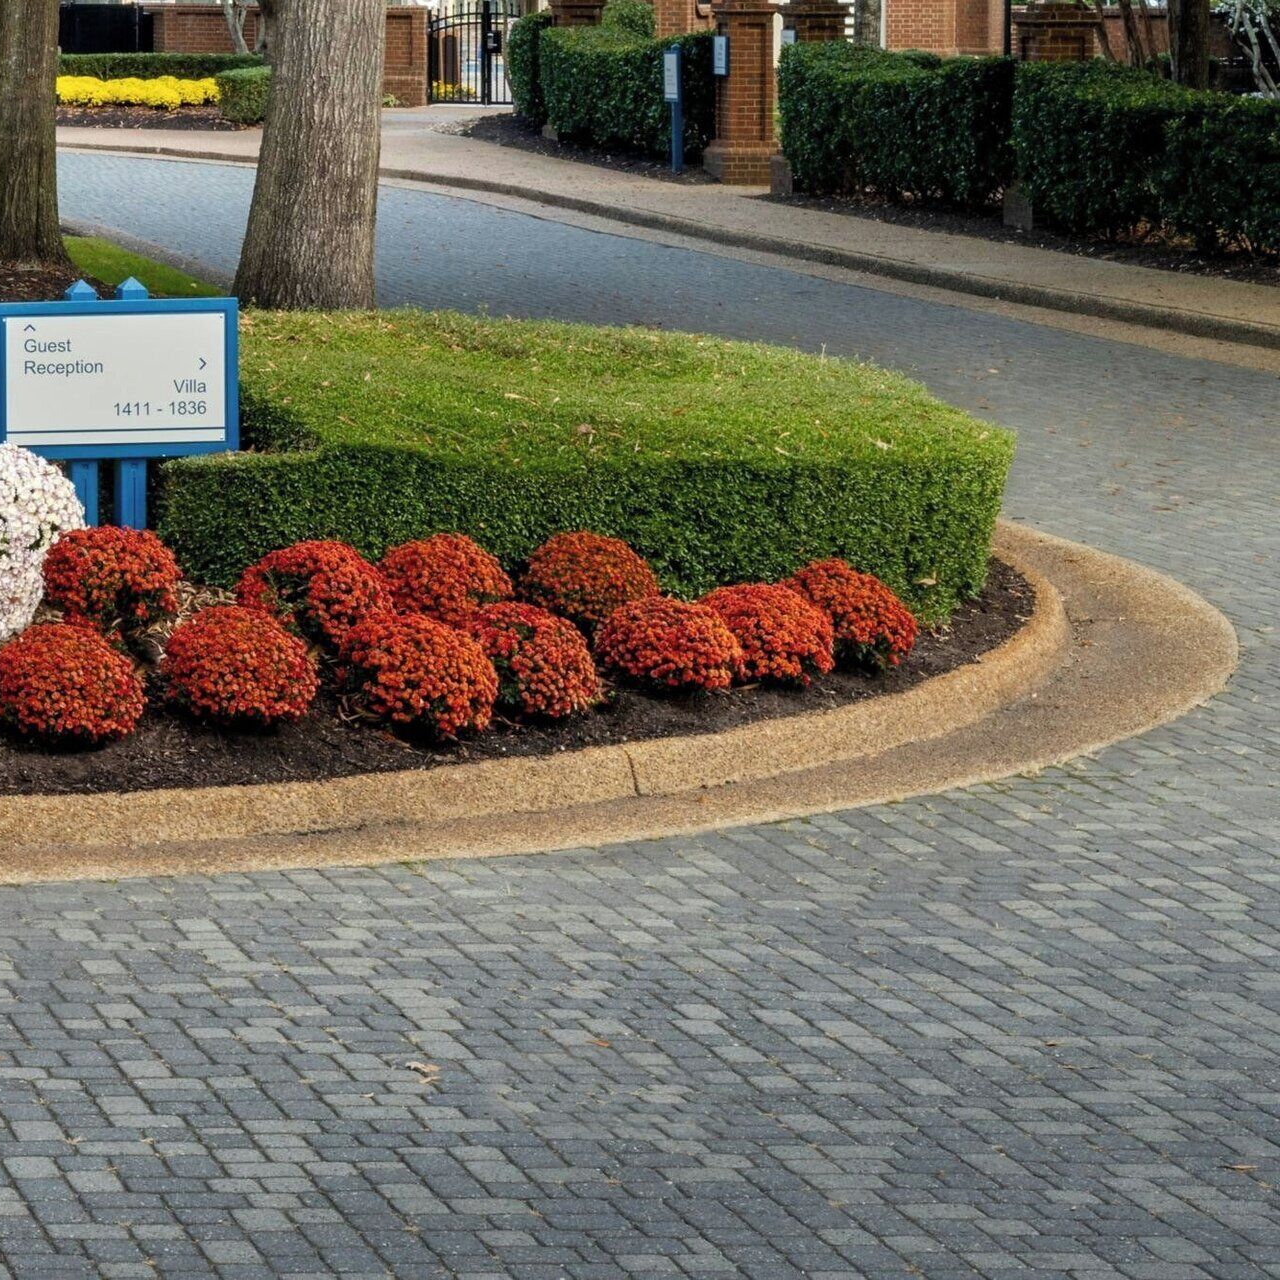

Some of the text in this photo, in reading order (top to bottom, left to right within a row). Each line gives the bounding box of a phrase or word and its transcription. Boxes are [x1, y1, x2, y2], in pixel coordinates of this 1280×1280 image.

[24, 338, 72, 354] Guest
[24, 359, 104, 378] Reception
[173, 378, 207, 394] Villa
[114, 401, 151, 417] 1411
[169, 400, 207, 416] 1836
